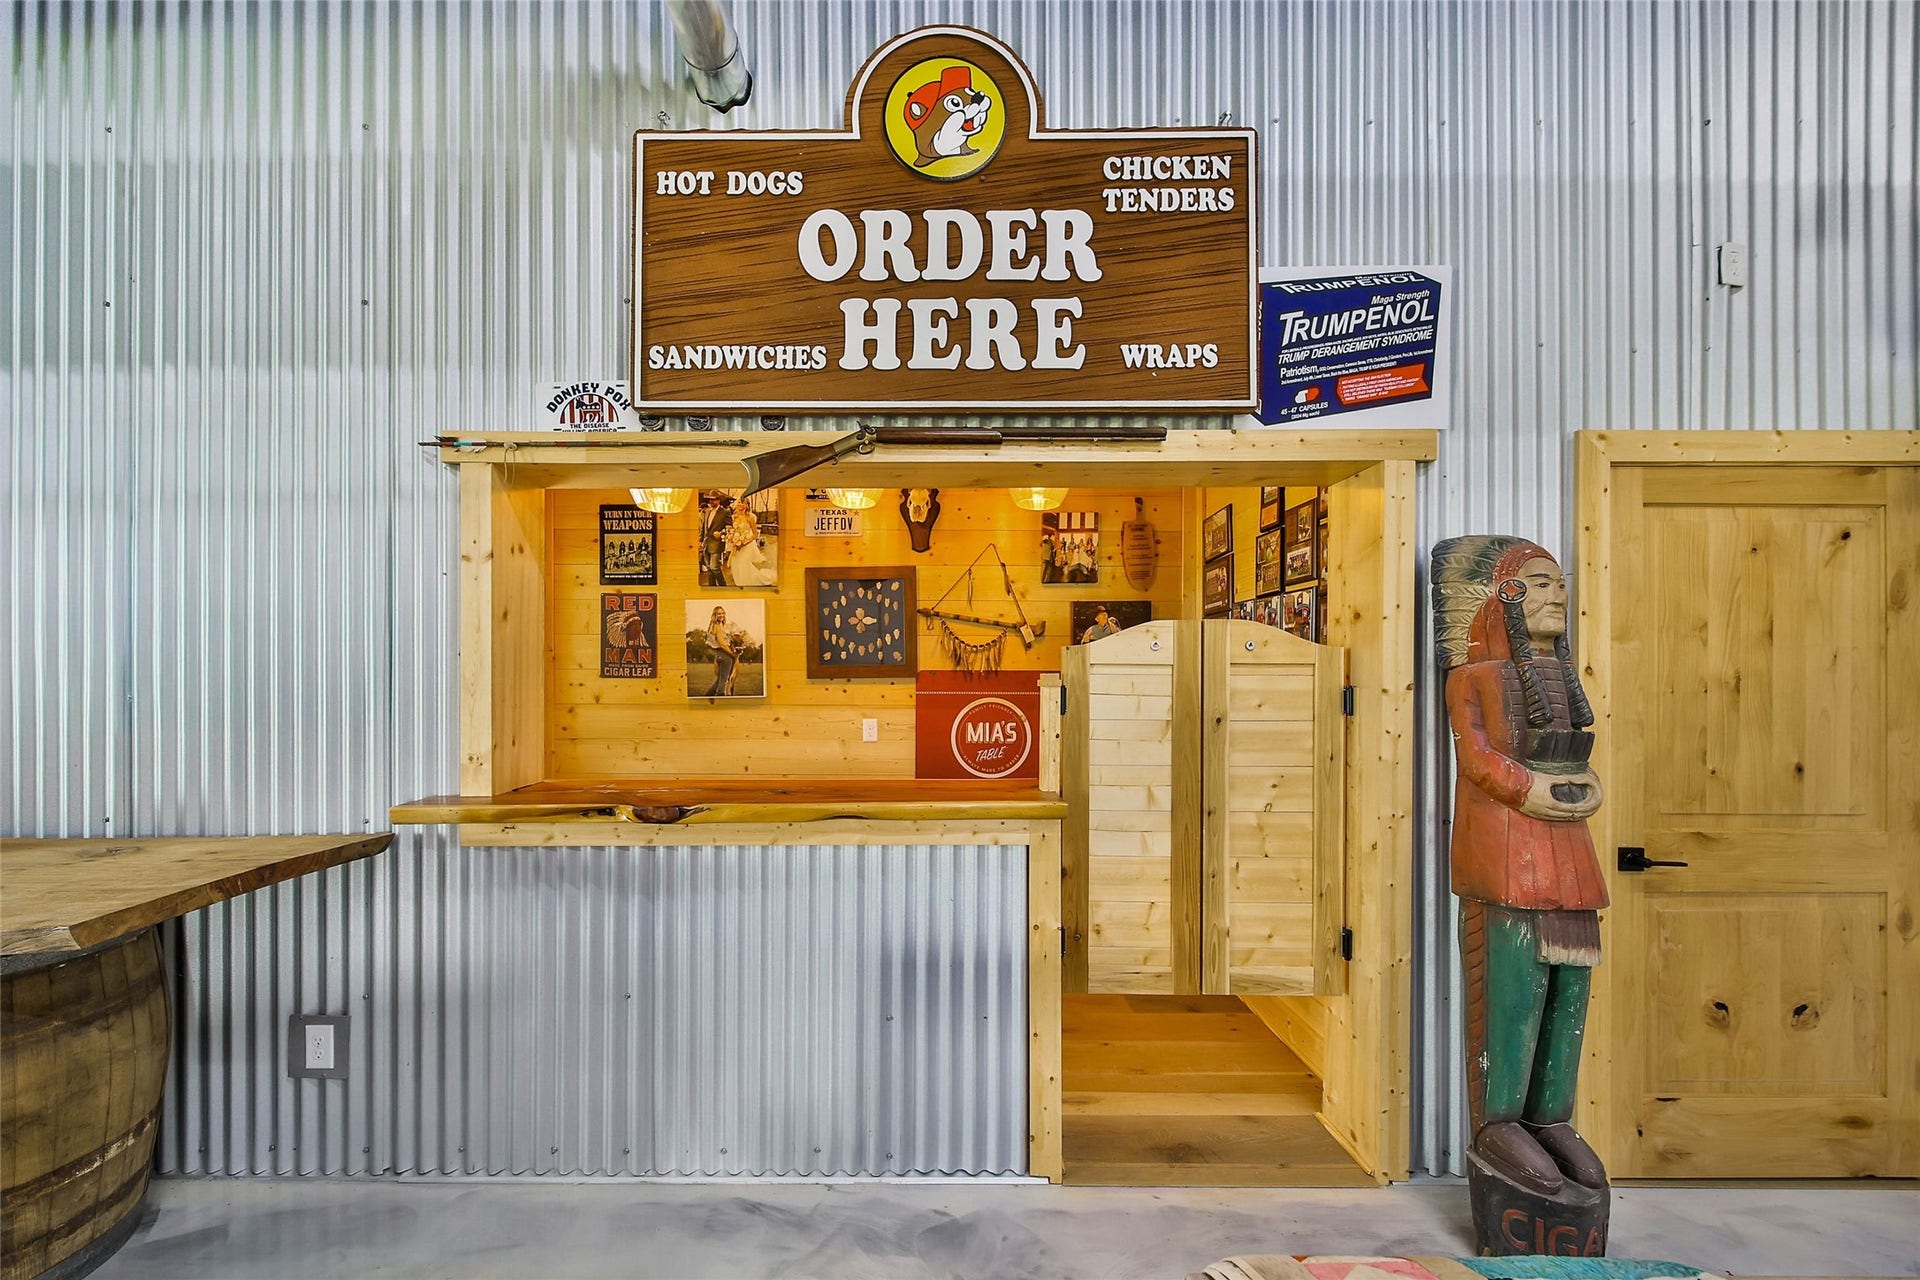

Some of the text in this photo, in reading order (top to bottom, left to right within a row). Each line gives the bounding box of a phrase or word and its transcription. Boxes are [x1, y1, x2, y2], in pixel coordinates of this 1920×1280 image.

[1103, 155, 1232, 180] CHICKEN
[656, 171, 803, 195] HOT DOGS
[1102, 187, 1234, 212] TENDERS
[798, 208, 1102, 282] ORDER
[1371, 290, 1430, 305] Maga Strength
[839, 297, 1086, 371] HERE
[649, 345, 827, 369] SANDWICHES
[1120, 343, 1218, 369] WRAPS
[1278, 350, 1310, 364] TRUMP
[1311, 338, 1381, 359] DERANGEMENT
[1381, 329, 1433, 347] SYNDROME
[546, 382, 631, 413] DONKEY POX
[1299, 401, 1329, 412] CAPSULES
[603, 519, 653, 531] WEAPONS
[604, 510, 652, 519] TURN IN YOUR
[606, 596, 654, 612] RED
[606, 648, 651, 664] MAN
[604, 667, 652, 676] CIGAR LEAF
[966, 720, 1017, 744] MIA'S
[975, 745, 1007, 762] TABLE
[1501, 1208, 1608, 1257] CIGA
